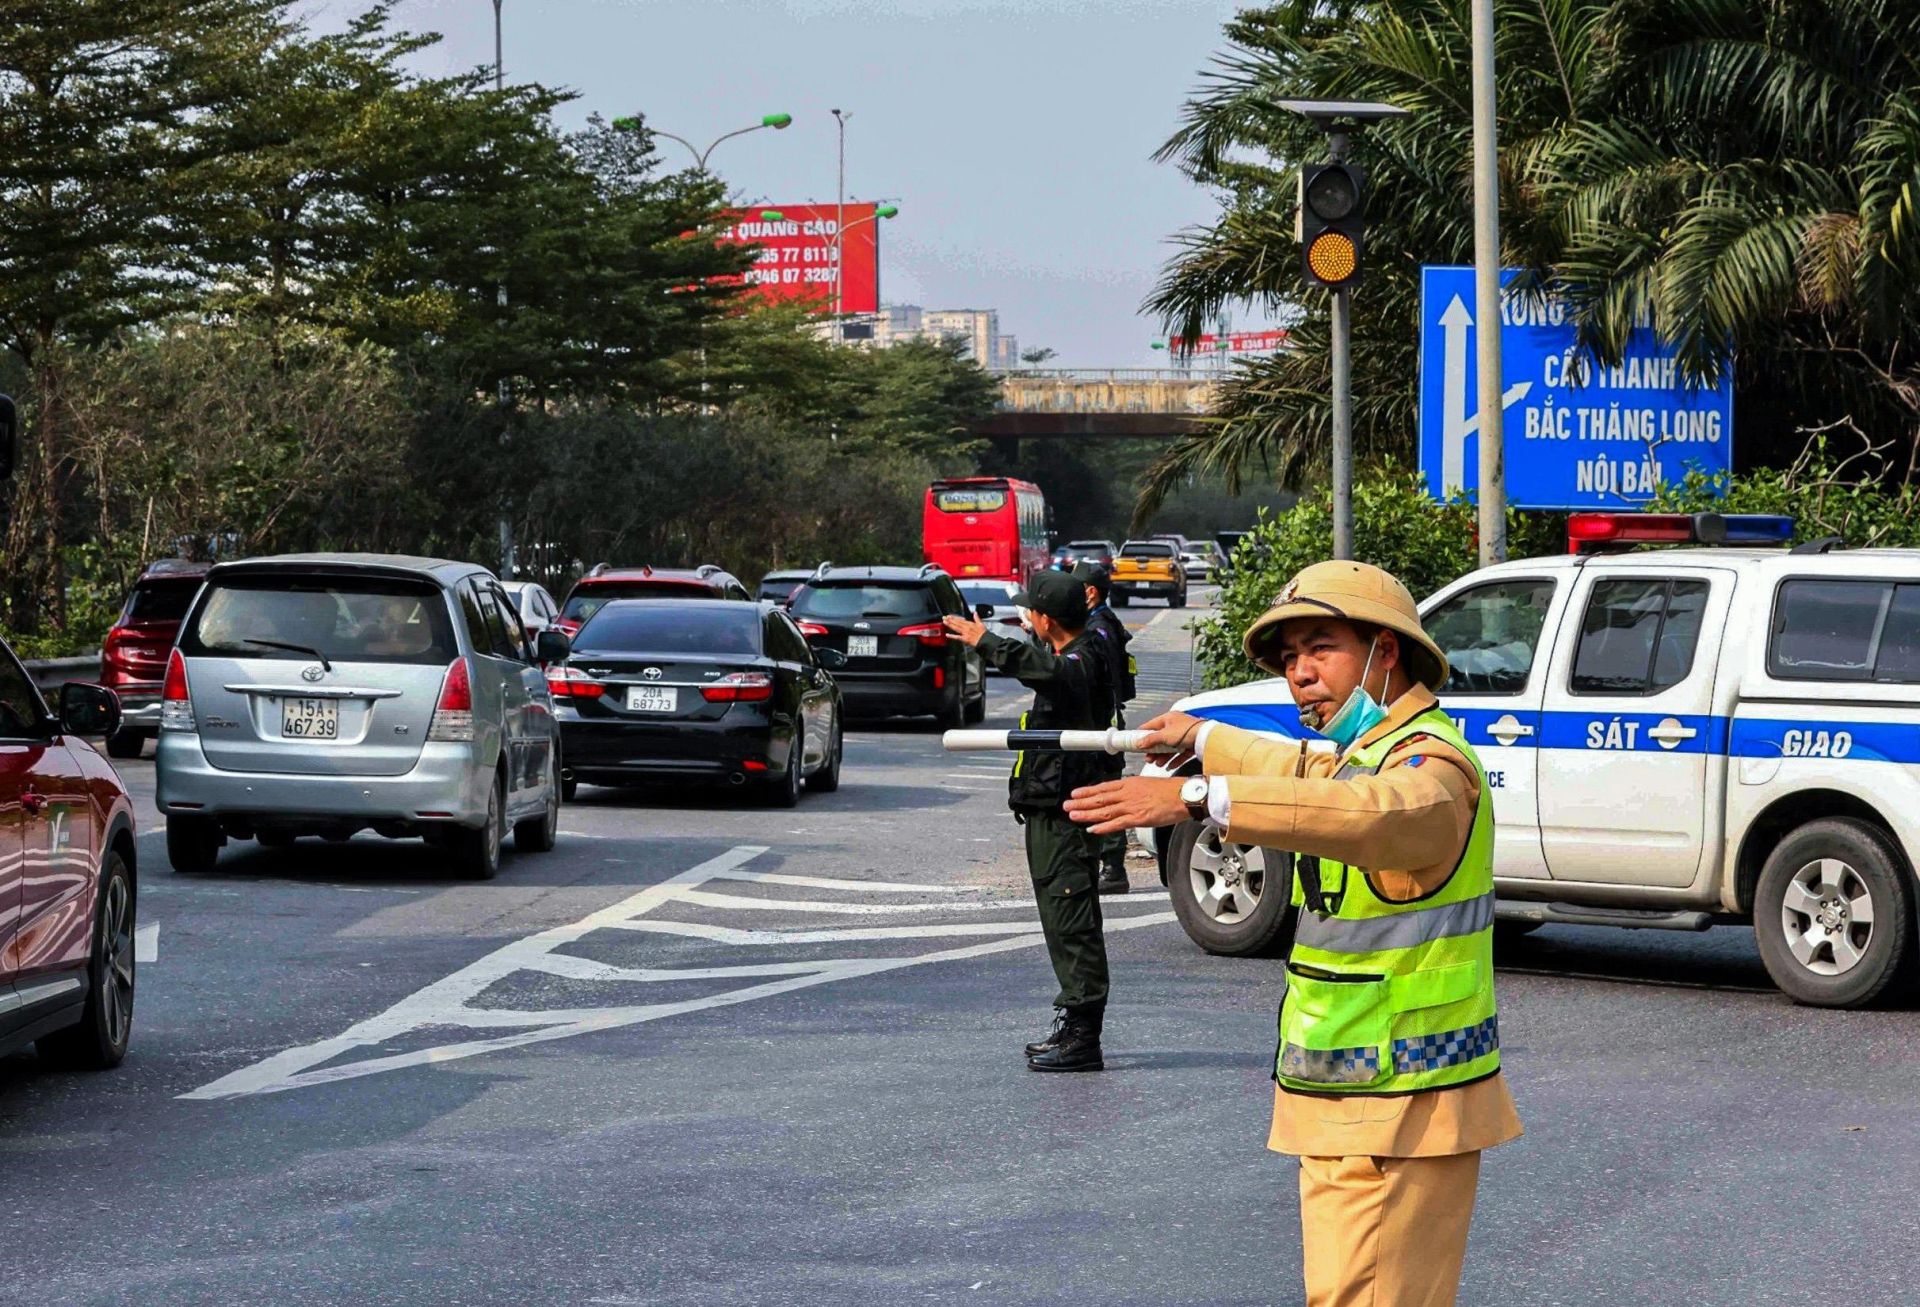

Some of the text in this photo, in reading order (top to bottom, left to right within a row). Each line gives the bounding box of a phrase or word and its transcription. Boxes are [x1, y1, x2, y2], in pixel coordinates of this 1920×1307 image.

[783, 247, 800, 262] 77
[782, 268, 800, 283] 07
[1525, 394, 1721, 443] BẮC THĂNG LONG
[1576, 452, 1617, 500] NỘI
[642, 687, 663, 698] 20A
[298, 699, 325, 717] 15A
[632, 698, 672, 711] 687.73
[284, 717, 336, 736] 467.39
[1586, 716, 1641, 750] SÁT
[1782, 729, 1853, 758] GIAO
